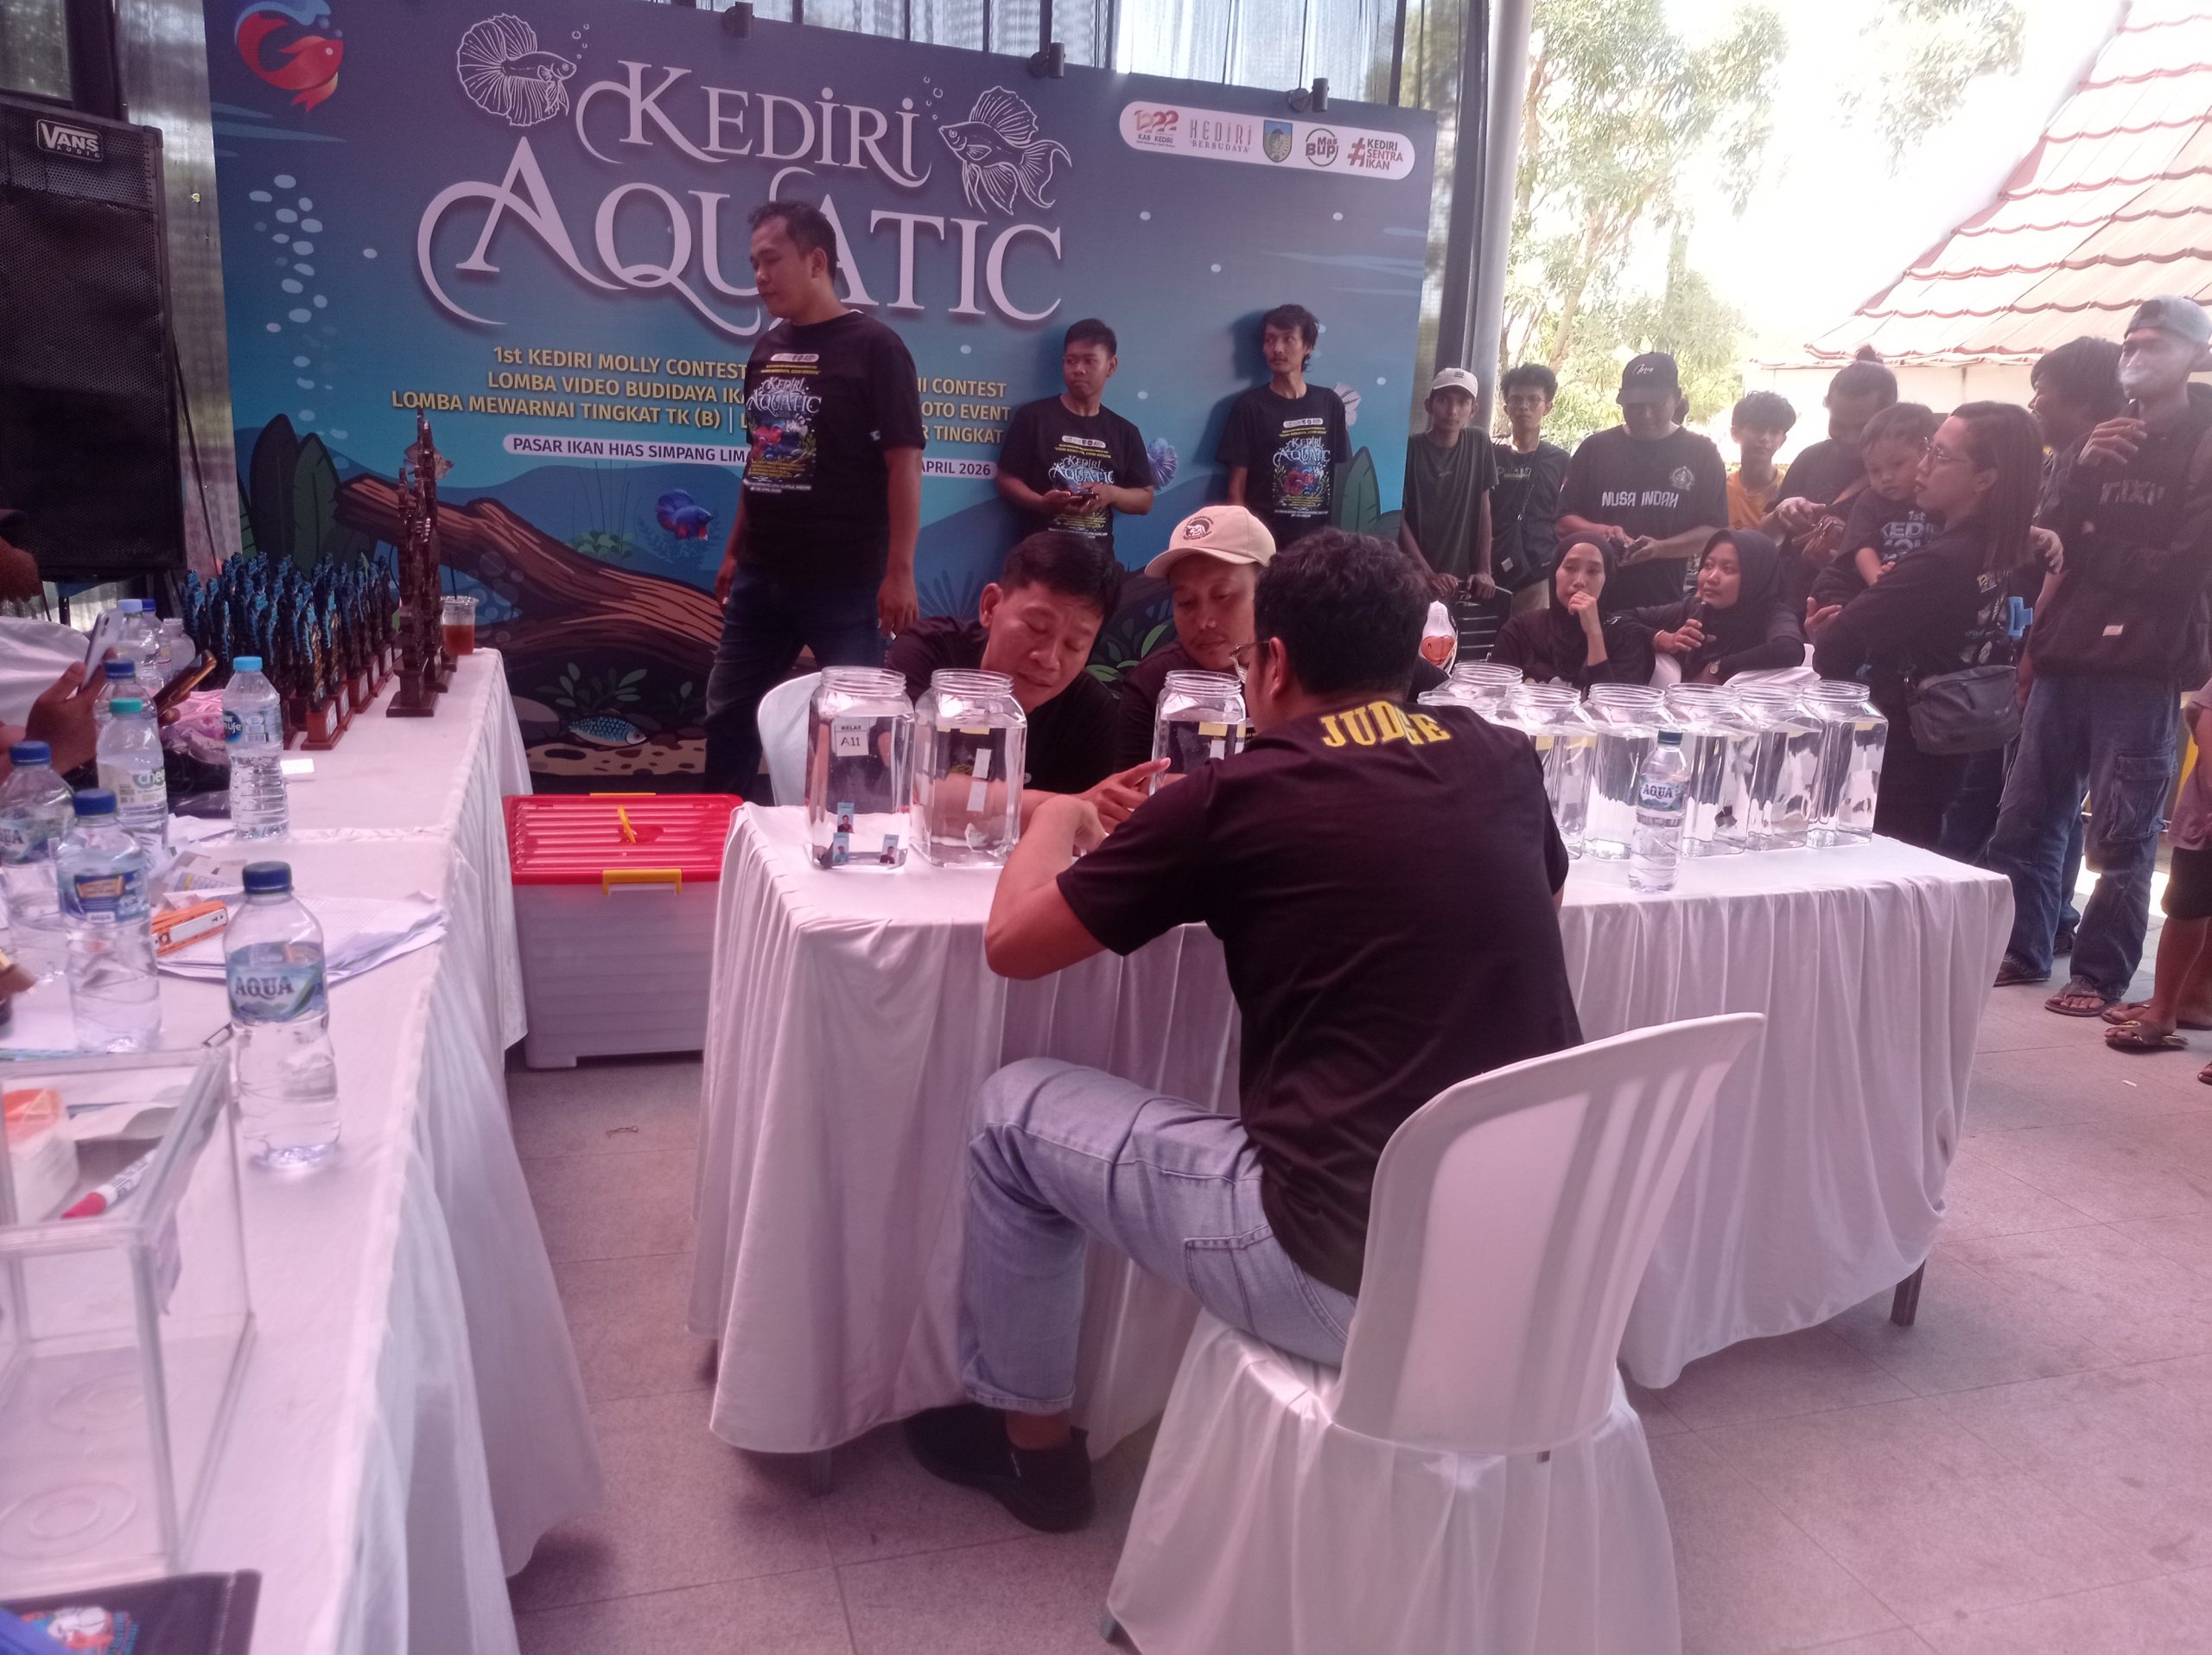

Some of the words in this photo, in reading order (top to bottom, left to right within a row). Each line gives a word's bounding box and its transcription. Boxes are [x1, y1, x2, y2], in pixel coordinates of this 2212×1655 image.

[40, 123, 99, 152] VANS
[1317, 137, 1338, 146] Mas
[1367, 138, 1398, 151] KEDIRI
[56, 144, 100, 158] AUDIO
[1191, 140, 1250, 153] BERBUDAYA
[1367, 149, 1403, 162] SENTRA
[1365, 160, 1390, 170] IKAN
[493, 346, 523, 364] 1st
[529, 348, 592, 369] KEDIRI
[598, 353, 660, 373] MOLLY
[665, 359, 747, 379] CONTEST
[488, 371, 557, 391] LOMBA
[562, 377, 620, 396] VIDEO
[626, 381, 717, 402] BUDIDAYA
[932, 379, 1007, 398] CONTEST
[392, 390, 463, 411] LOMBA
[469, 395, 575, 418] MEWARNAI
[581, 402, 660, 423] TINGKAT
[664, 408, 690, 425] TK
[694, 407, 721, 429] (B)
[960, 404, 1011, 421] EVENT
[934, 425, 1004, 443] TINGKAT
[513, 438, 562, 453] PASAR
[567, 441, 603, 455] IKAN
[609, 443, 644, 457] HIAS
[648, 445, 715, 461] SIMPANG
[720, 449, 748, 463] LIM
[959, 462, 991, 476] 2026
[1601, 491, 1636, 506] NUSA
[1641, 490, 1680, 507] INDAH
[1319, 701, 1451, 747] JUDGE
[841, 736, 861, 746] A11
[1643, 784, 1673, 799] AQUA
[235, 976, 295, 1000] AQUA
